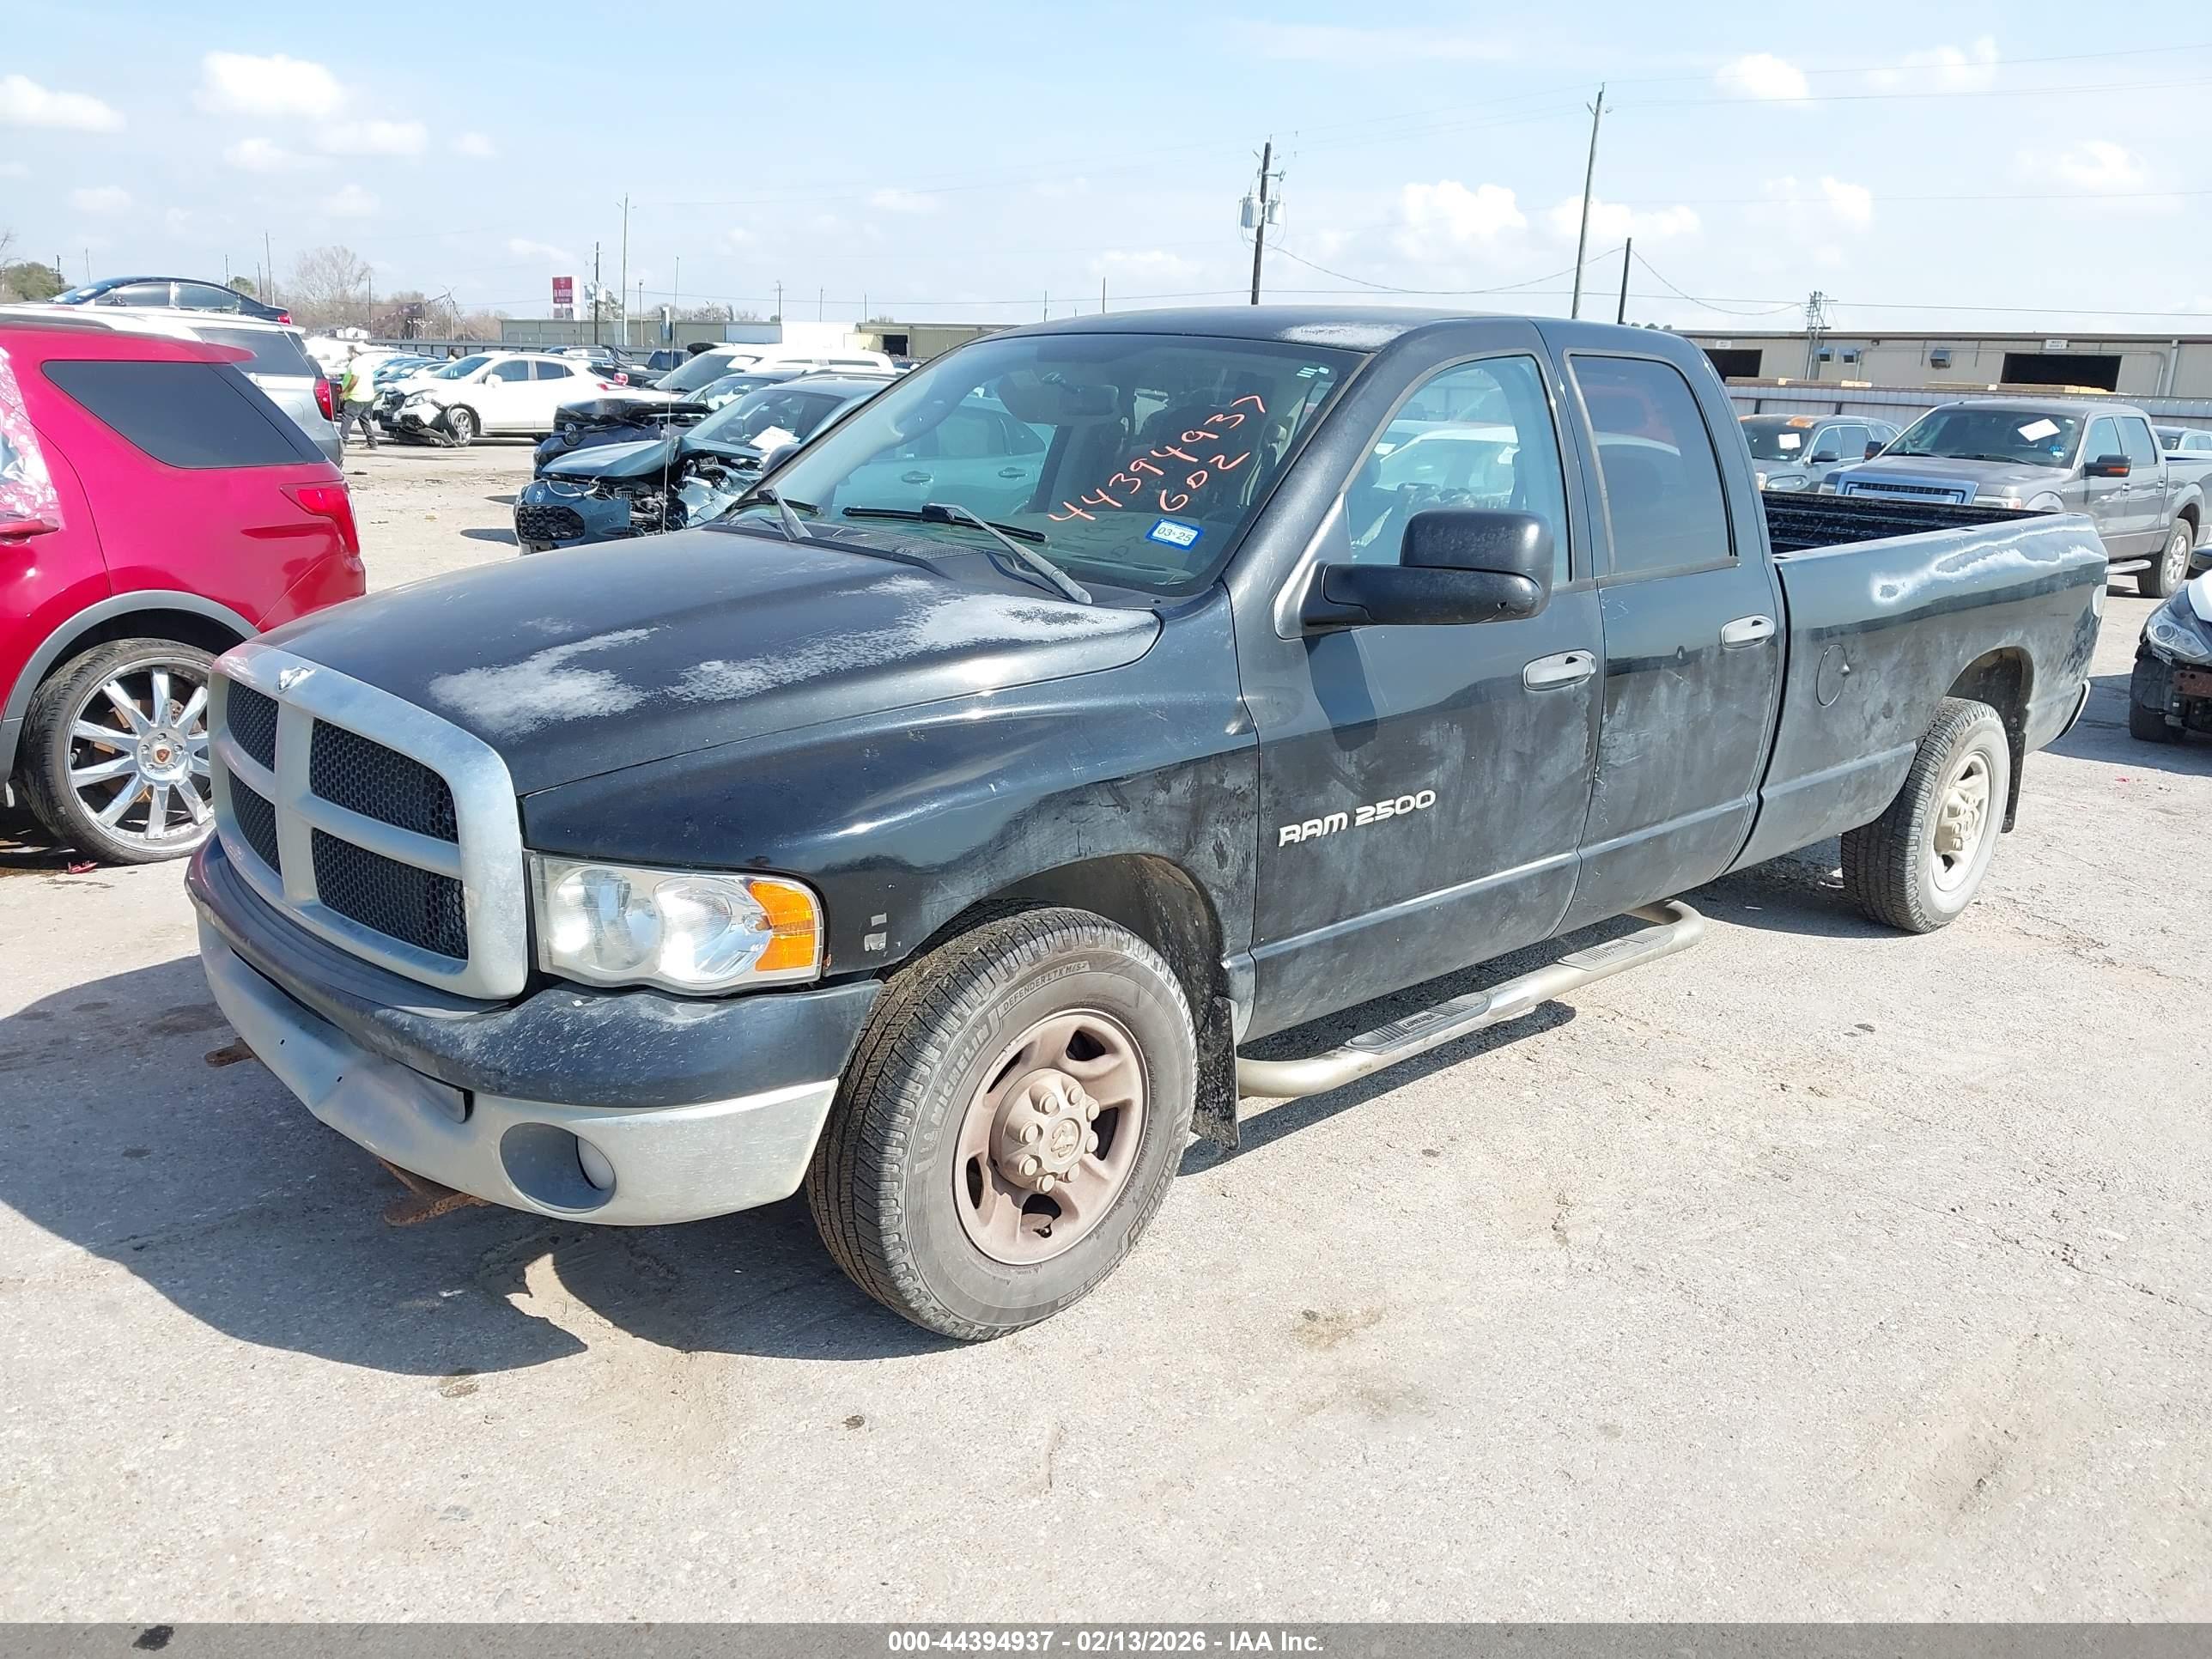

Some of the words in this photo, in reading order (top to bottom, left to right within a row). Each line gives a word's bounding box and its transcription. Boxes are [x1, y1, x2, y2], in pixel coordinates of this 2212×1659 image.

[1046, 394, 1267, 522] 44394937
[1159, 451, 1251, 513] 602
[1157, 526, 1173, 537] 03
[1175, 531, 1194, 542] 25
[1278, 811, 1349, 848] RAM
[1353, 788, 1437, 827] 2500
[1002, 975, 1047, 1012] DEFENDER
[1047, 969, 1064, 981] LTX
[930, 1023, 990, 1126] MICHELIN
